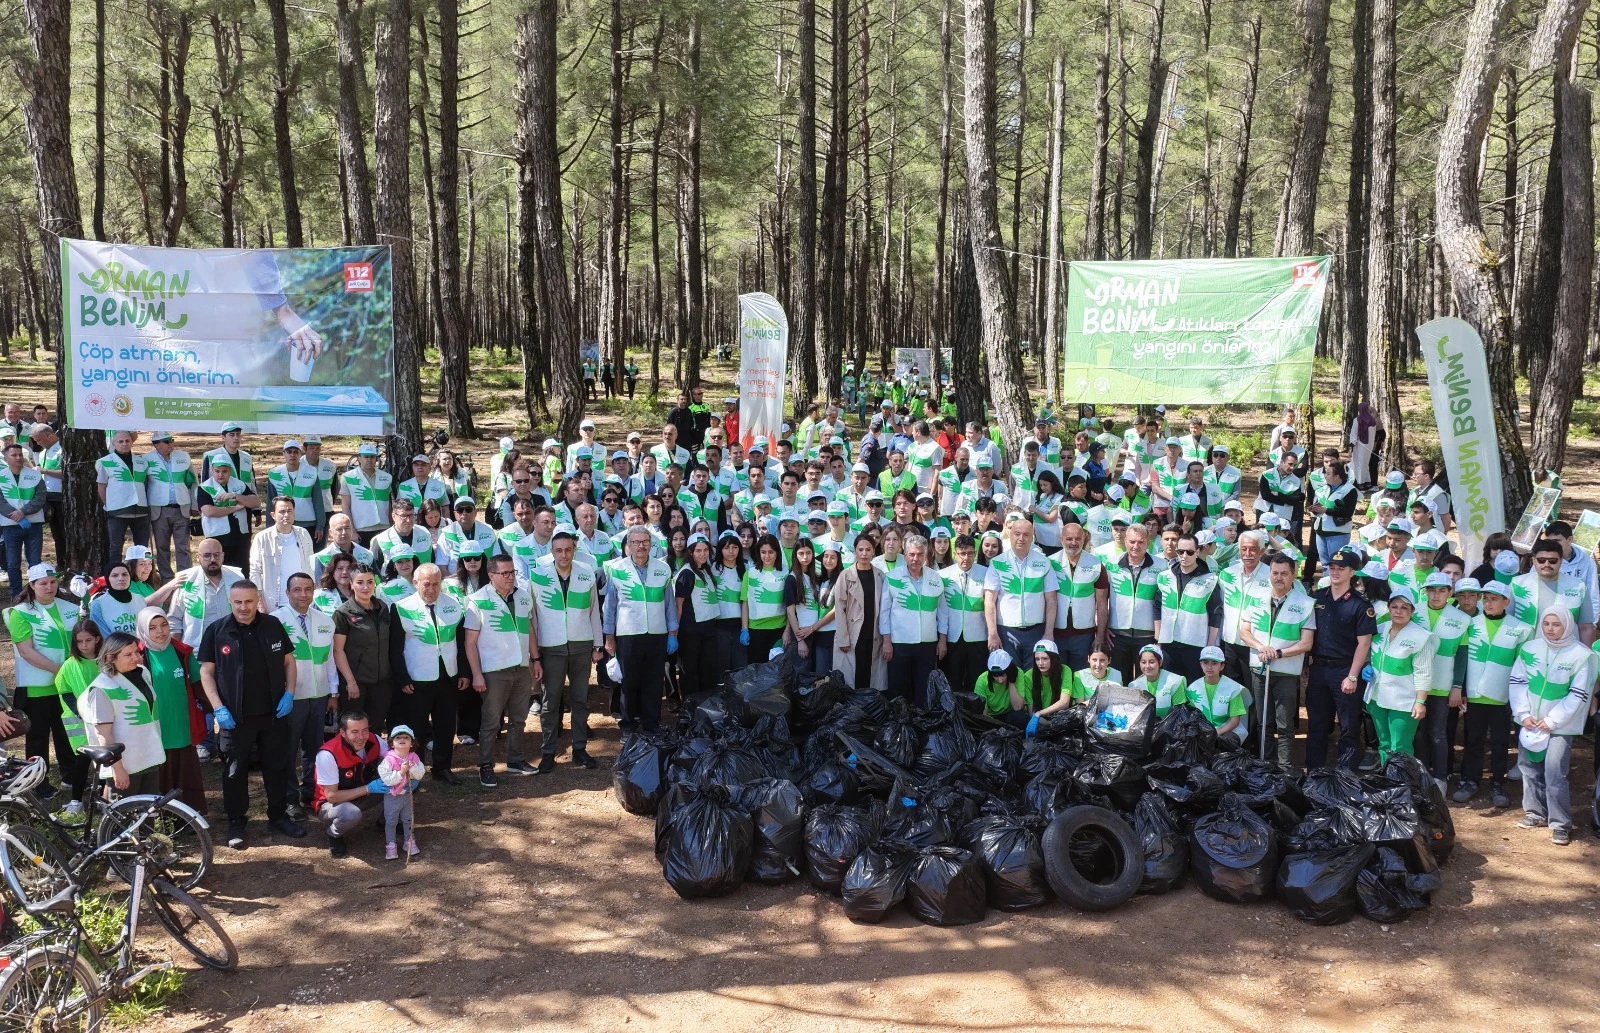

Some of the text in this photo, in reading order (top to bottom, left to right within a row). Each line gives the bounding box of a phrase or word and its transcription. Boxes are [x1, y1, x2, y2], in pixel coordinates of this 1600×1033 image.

[78, 261, 190, 300] ORMAN
[347, 266, 369, 278] 112
[1084, 276, 1180, 308] ORMAN
[79, 341, 201, 364] Çöp atmam,
[1133, 341, 1196, 360] yangını
[81, 366, 240, 389] yangını önlerim.
